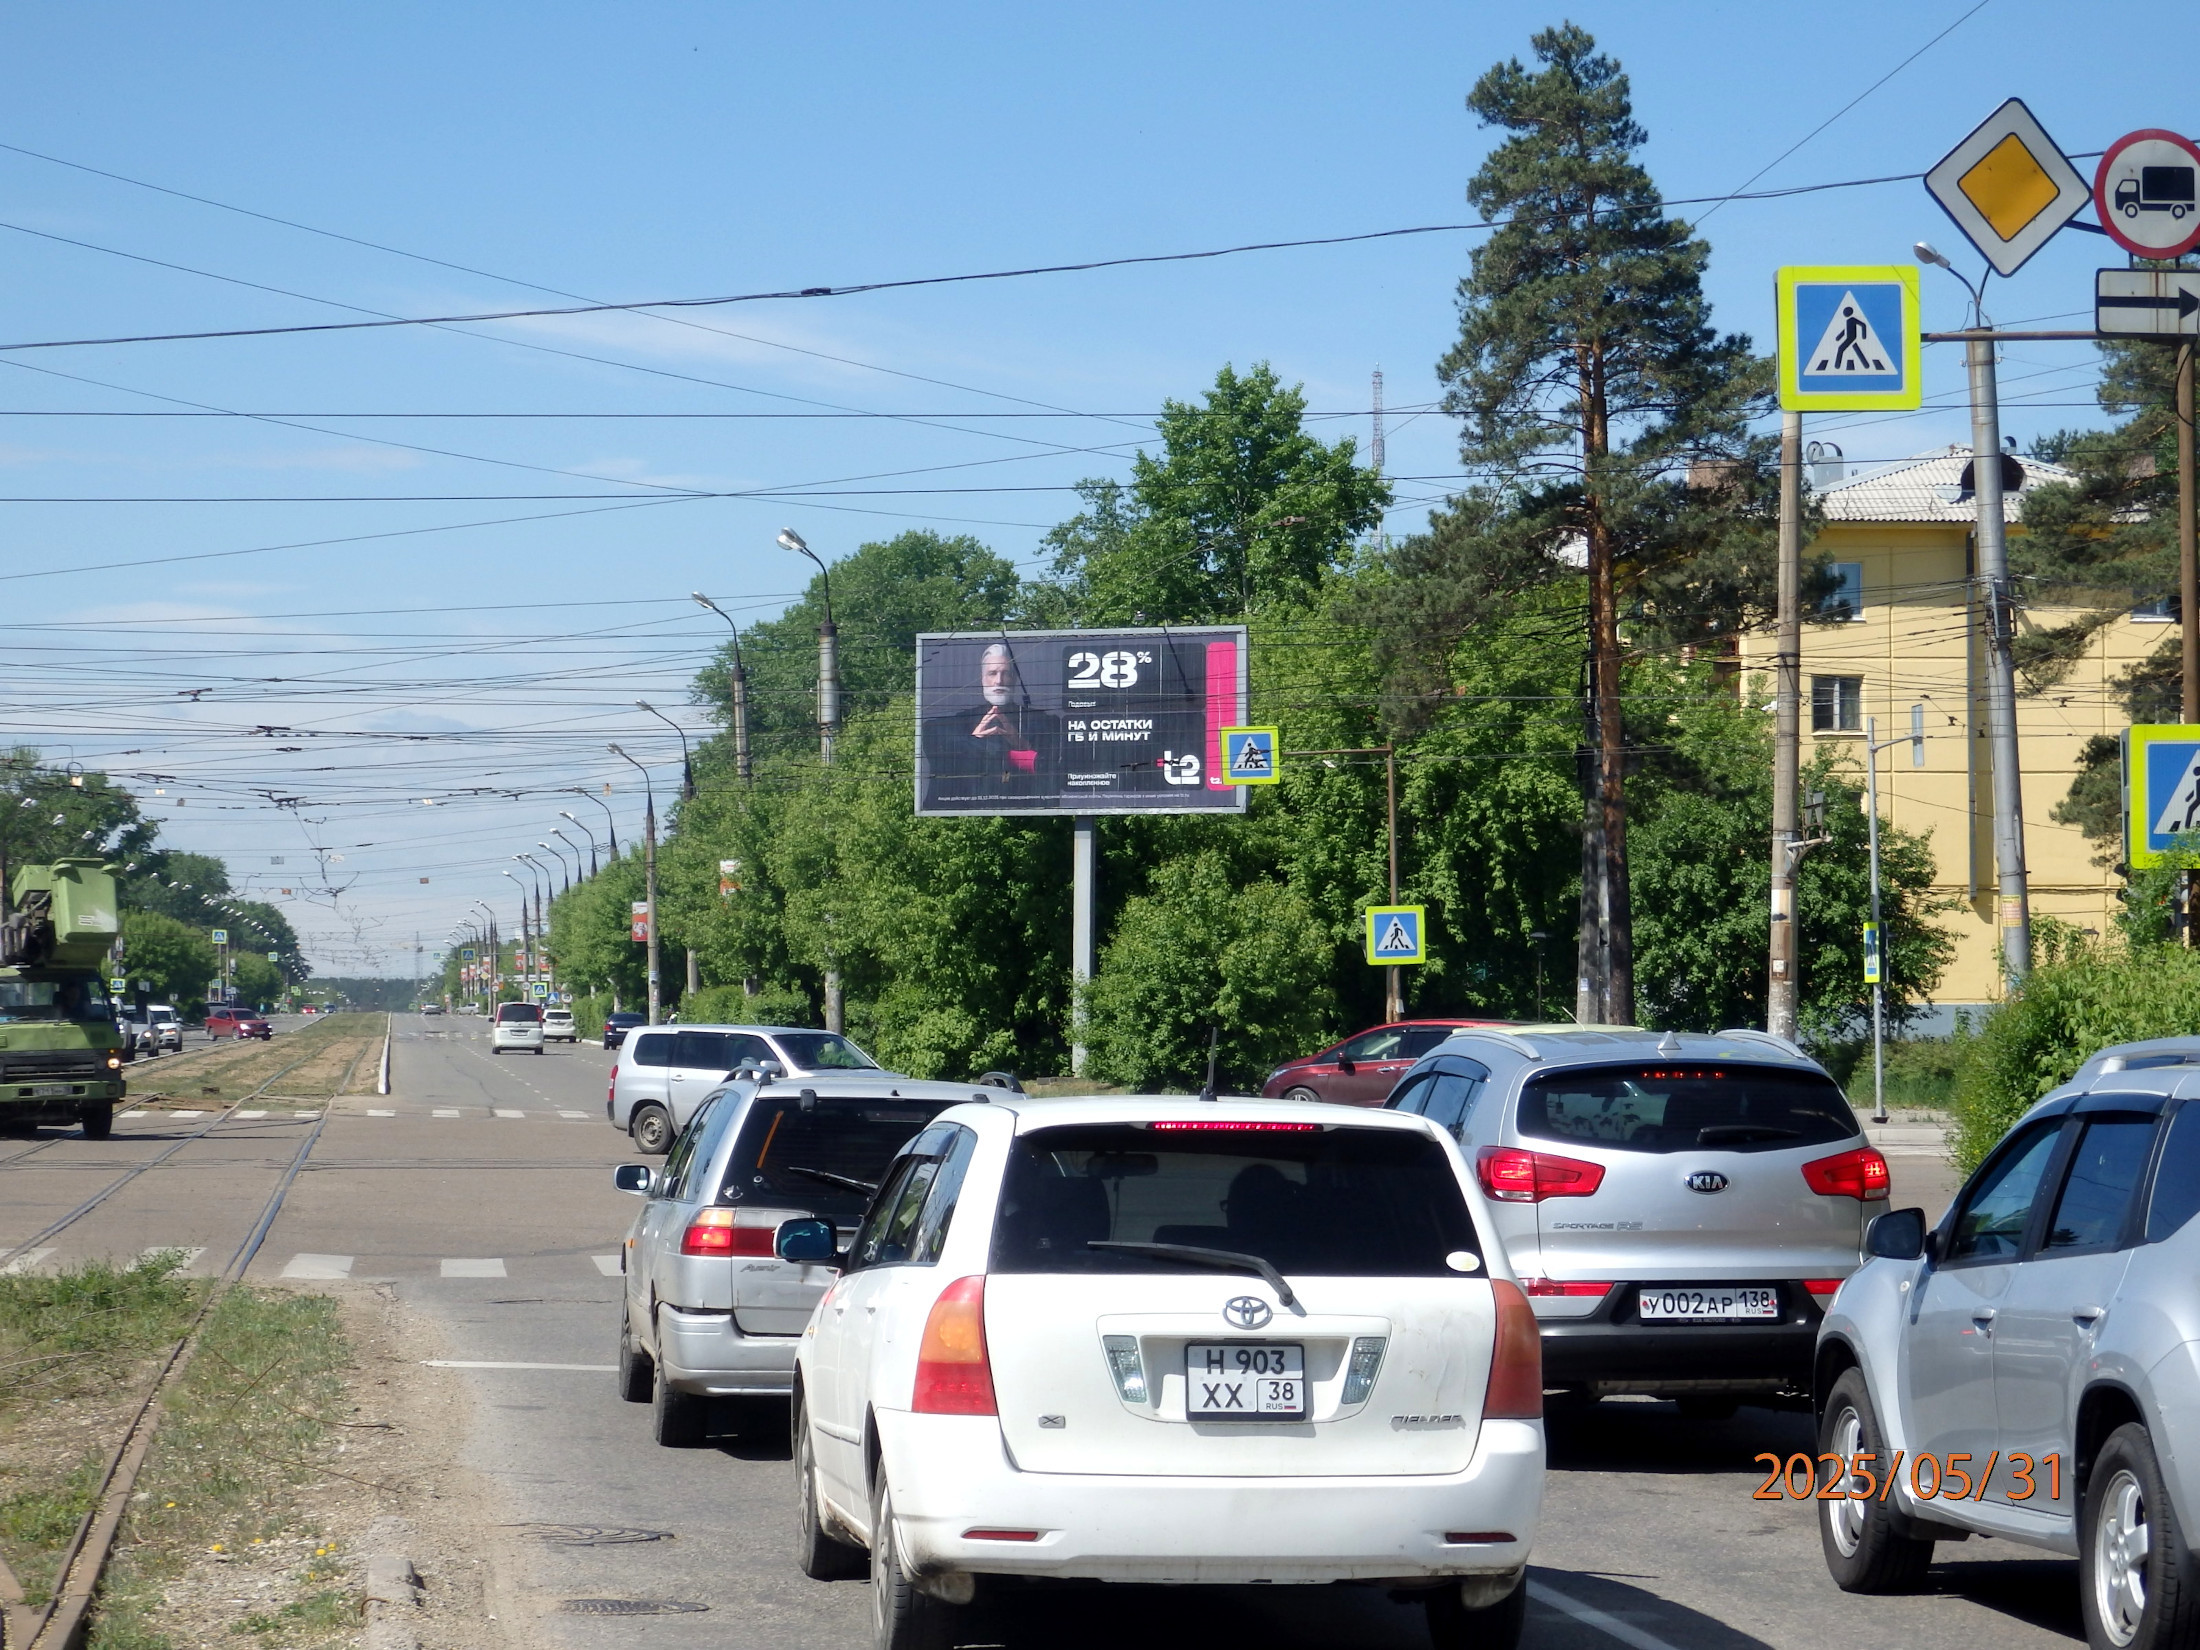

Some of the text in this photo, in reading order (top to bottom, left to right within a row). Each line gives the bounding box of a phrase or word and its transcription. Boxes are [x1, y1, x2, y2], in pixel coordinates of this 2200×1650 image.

[1068, 719, 1153, 731] НА ОСТАТКИ
[1068, 731, 1151, 742] ГБ И МИНУТ
[1692, 1175, 1724, 1189] KIA
[1206, 1349, 1285, 1375] Н 903
[1268, 1381, 1295, 1401] 38
[1265, 1402, 1284, 1410] RUS
